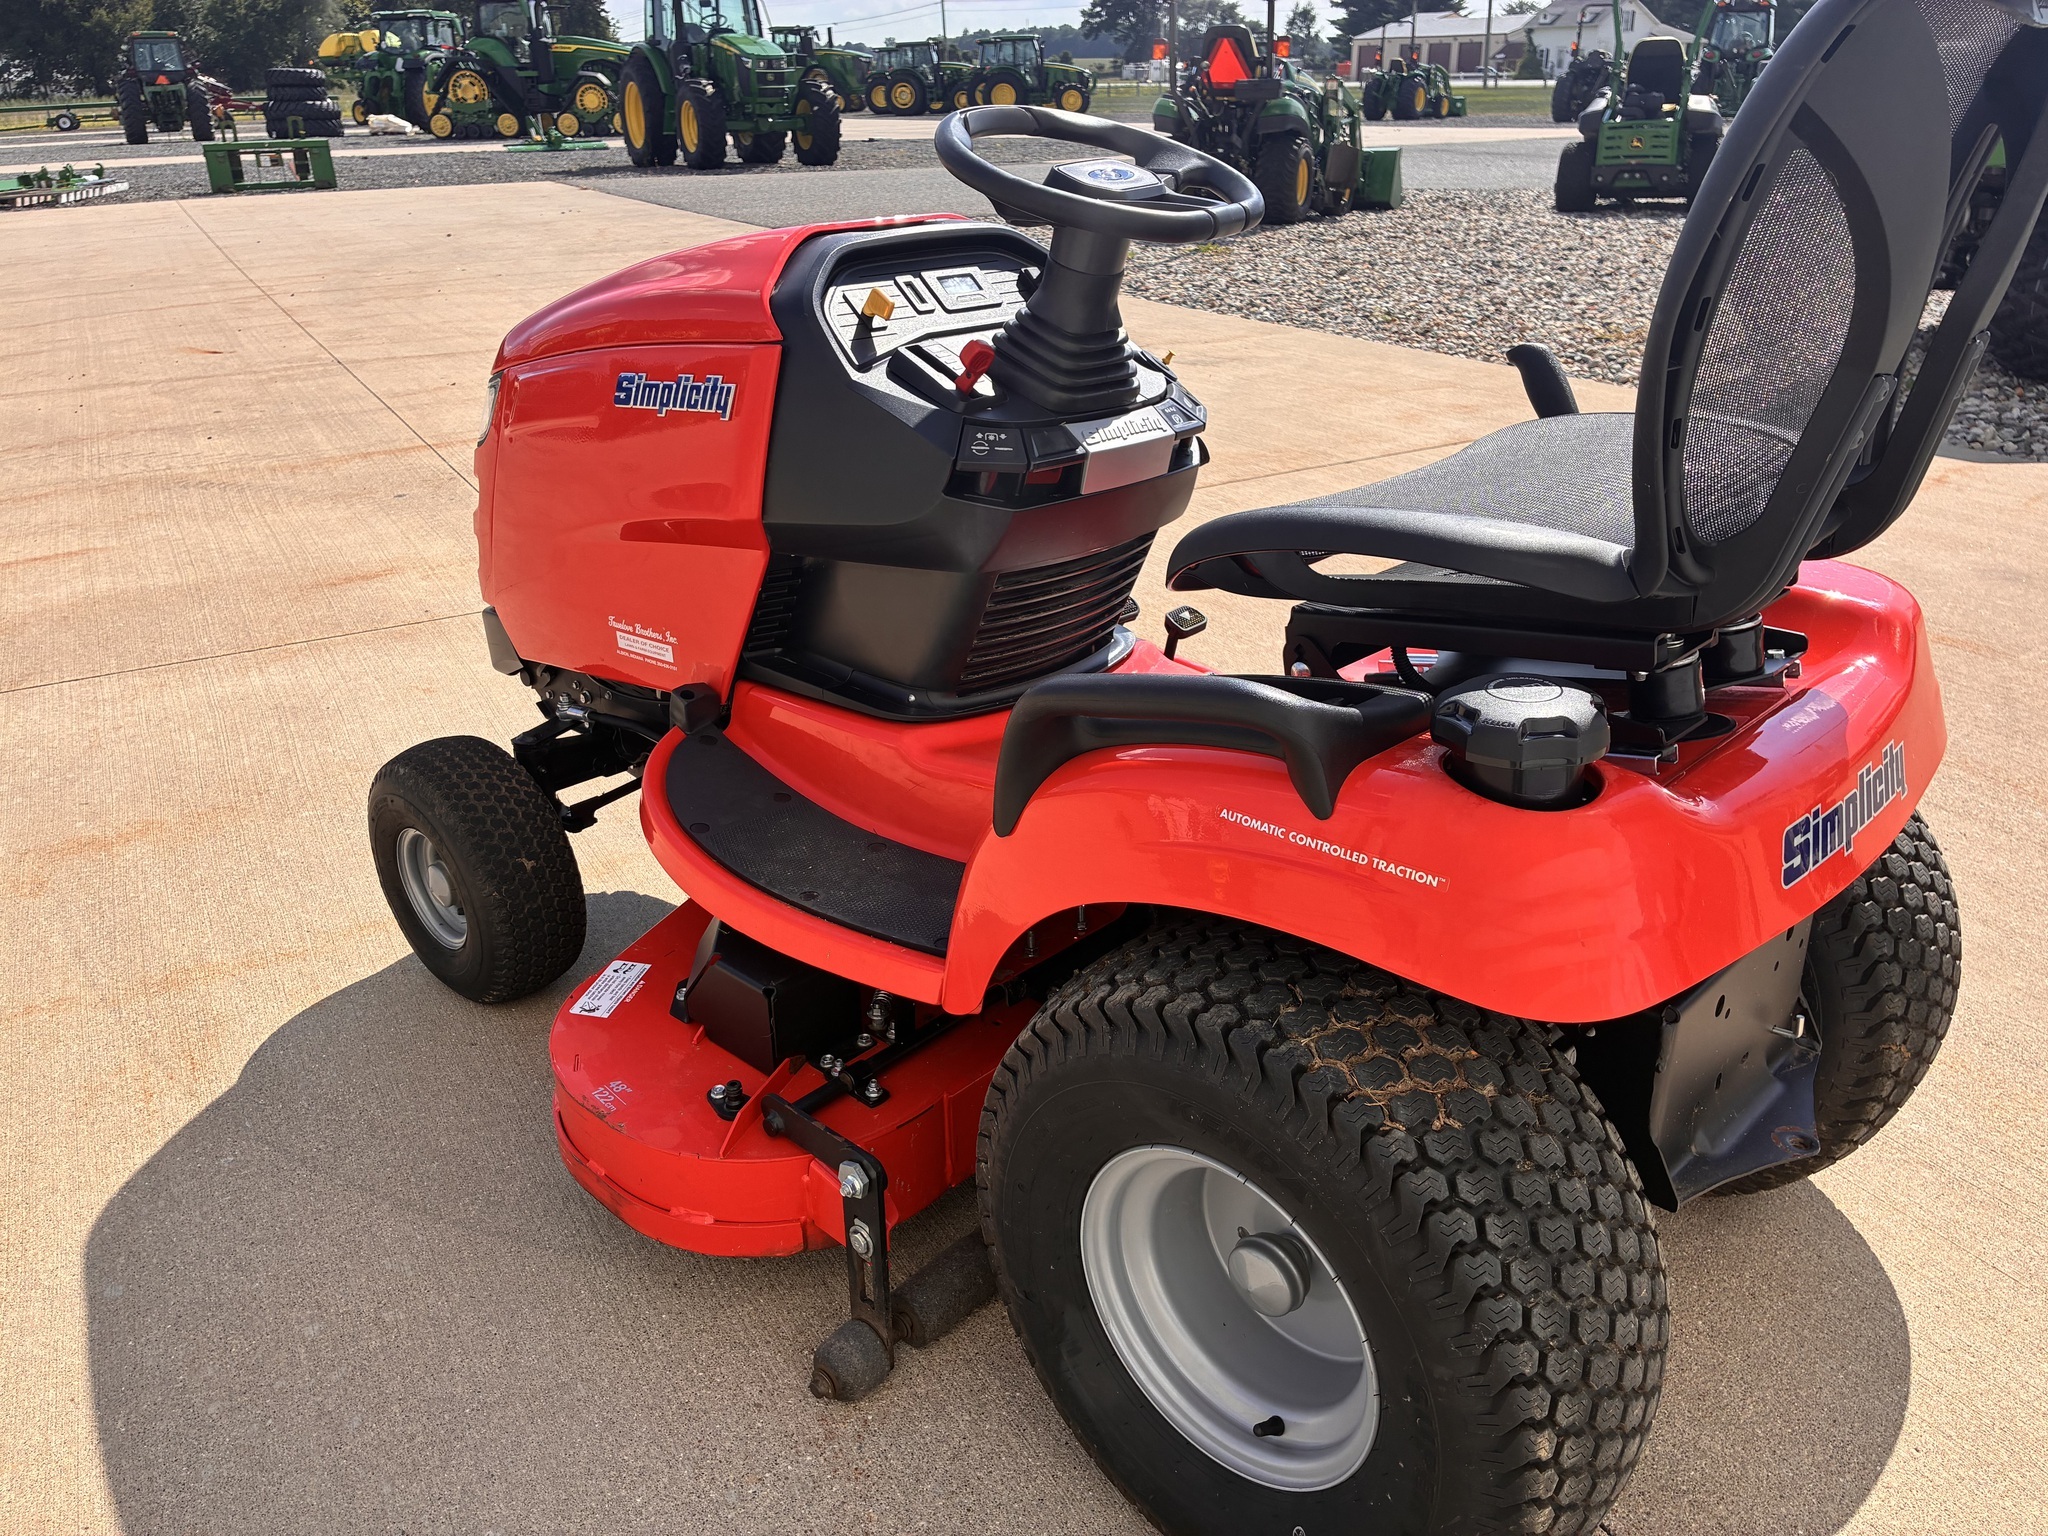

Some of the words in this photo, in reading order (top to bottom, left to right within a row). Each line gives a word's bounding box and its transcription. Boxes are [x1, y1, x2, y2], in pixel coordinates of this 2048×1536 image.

[614, 372, 736, 421] Simplicity
[1082, 417, 1167, 445] Simplicity
[619, 634, 640, 645] DEALER
[648, 642, 670, 653] CHOICE
[665, 631, 679, 645] Inc.
[1481, 718, 1516, 728] KELCH
[1781, 739, 1908, 889] Simplicity
[1220, 808, 1286, 839] AUTOMATIC
[1288, 831, 1369, 865] CONTROLLED
[624, 983, 644, 1003] DANGER
